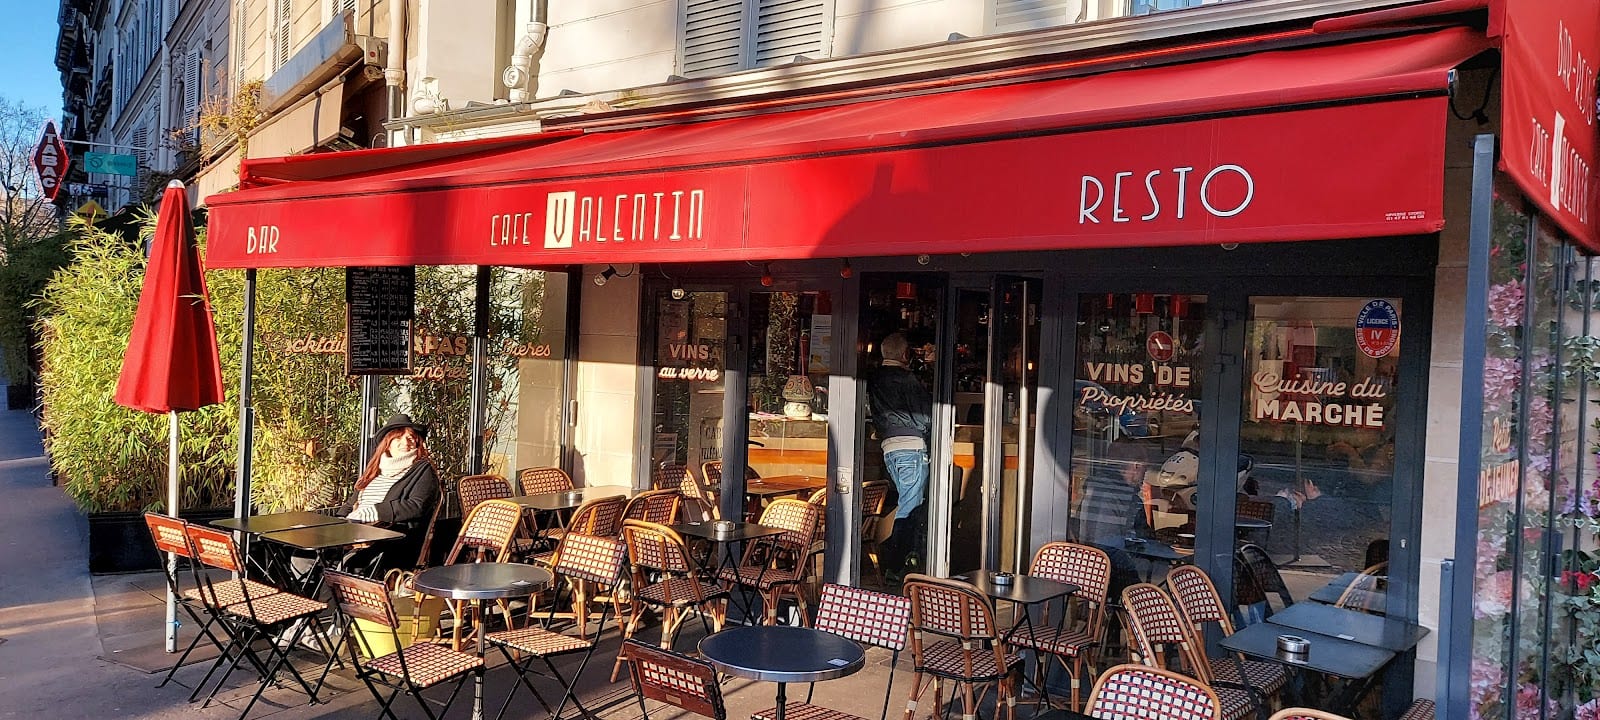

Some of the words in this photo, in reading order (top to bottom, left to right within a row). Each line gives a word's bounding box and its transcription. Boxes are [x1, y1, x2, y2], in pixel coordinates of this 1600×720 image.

[41, 133, 58, 188] TABAC
[1079, 164, 1254, 224] RESTO
[491, 213, 532, 246] CAFE
[544, 189, 704, 249] VALENTIN
[246, 225, 279, 254] BAR
[1358, 305, 1371, 324] VILLE
[1385, 305, 1397, 326] PARIS
[413, 335, 468, 356] APAS
[1370, 330, 1382, 340] IV
[669, 343, 709, 360] VINS
[658, 366, 678, 379] au
[678, 367, 719, 382] verre
[1086, 362, 1144, 384] VINS
[1157, 365, 1191, 387] DE
[1253, 371, 1347, 396] Cuisine
[1351, 376, 1386, 399] du
[1081, 386, 1194, 415] Propriétés
[1256, 398, 1384, 428] MARCHÉ
